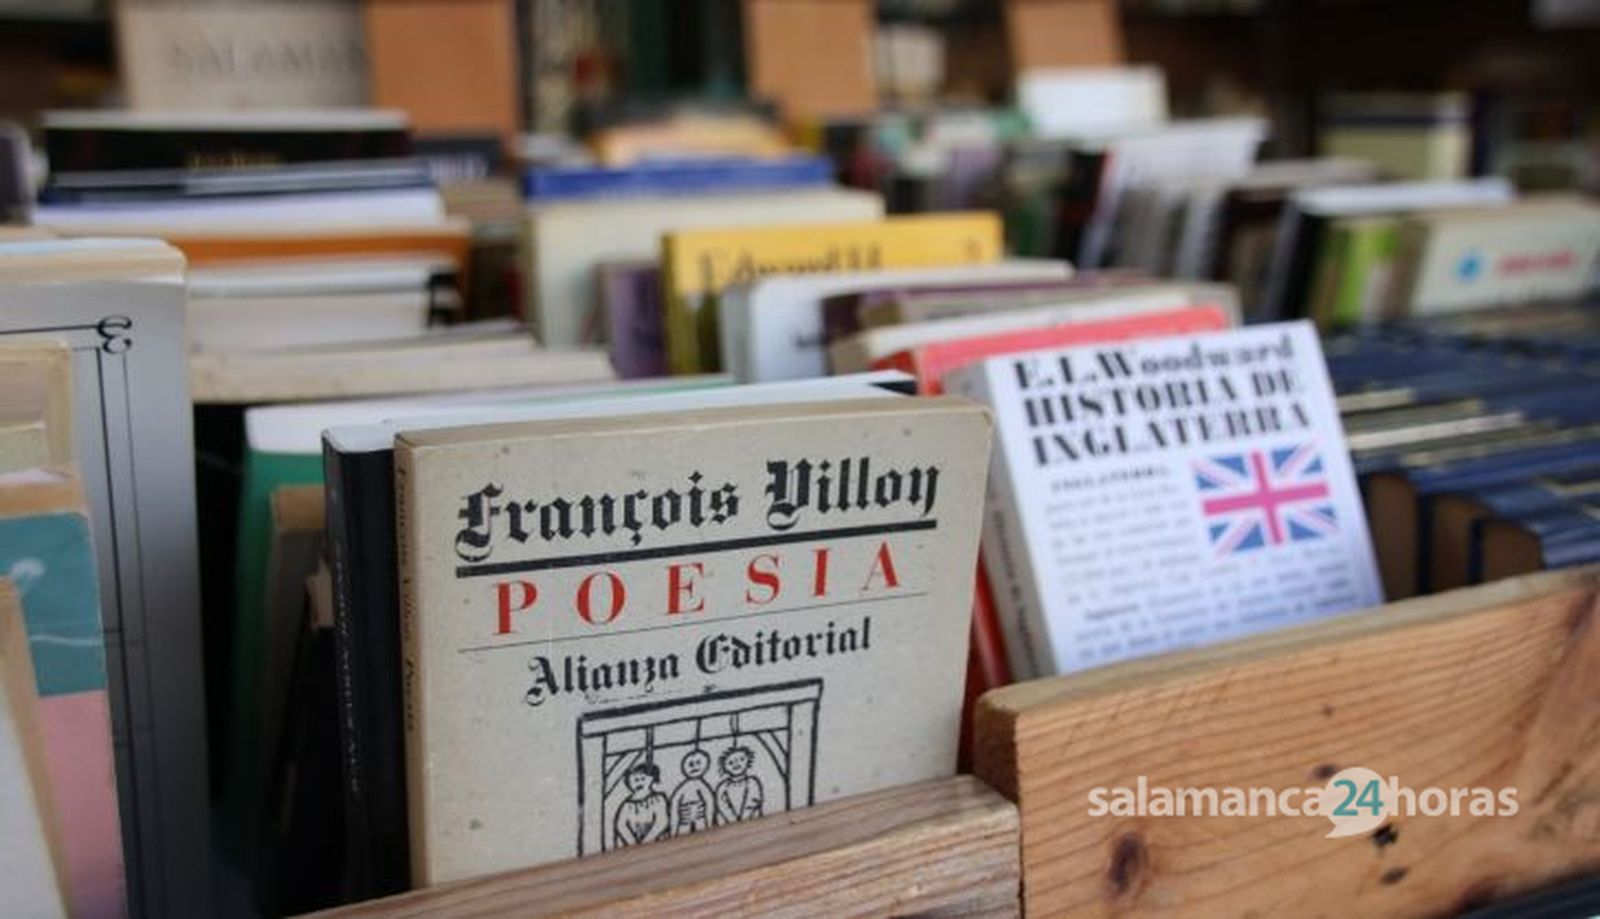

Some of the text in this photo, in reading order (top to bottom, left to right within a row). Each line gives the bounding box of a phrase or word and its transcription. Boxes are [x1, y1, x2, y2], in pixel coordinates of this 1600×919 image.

[1023, 367, 1303, 429] HISTORIA DE
[1032, 402, 1312, 467] INGLATERRA
[454, 457, 941, 562] François Villon
[491, 539, 904, 637] POESIA
[524, 615, 873, 707] Alianza Editorial
